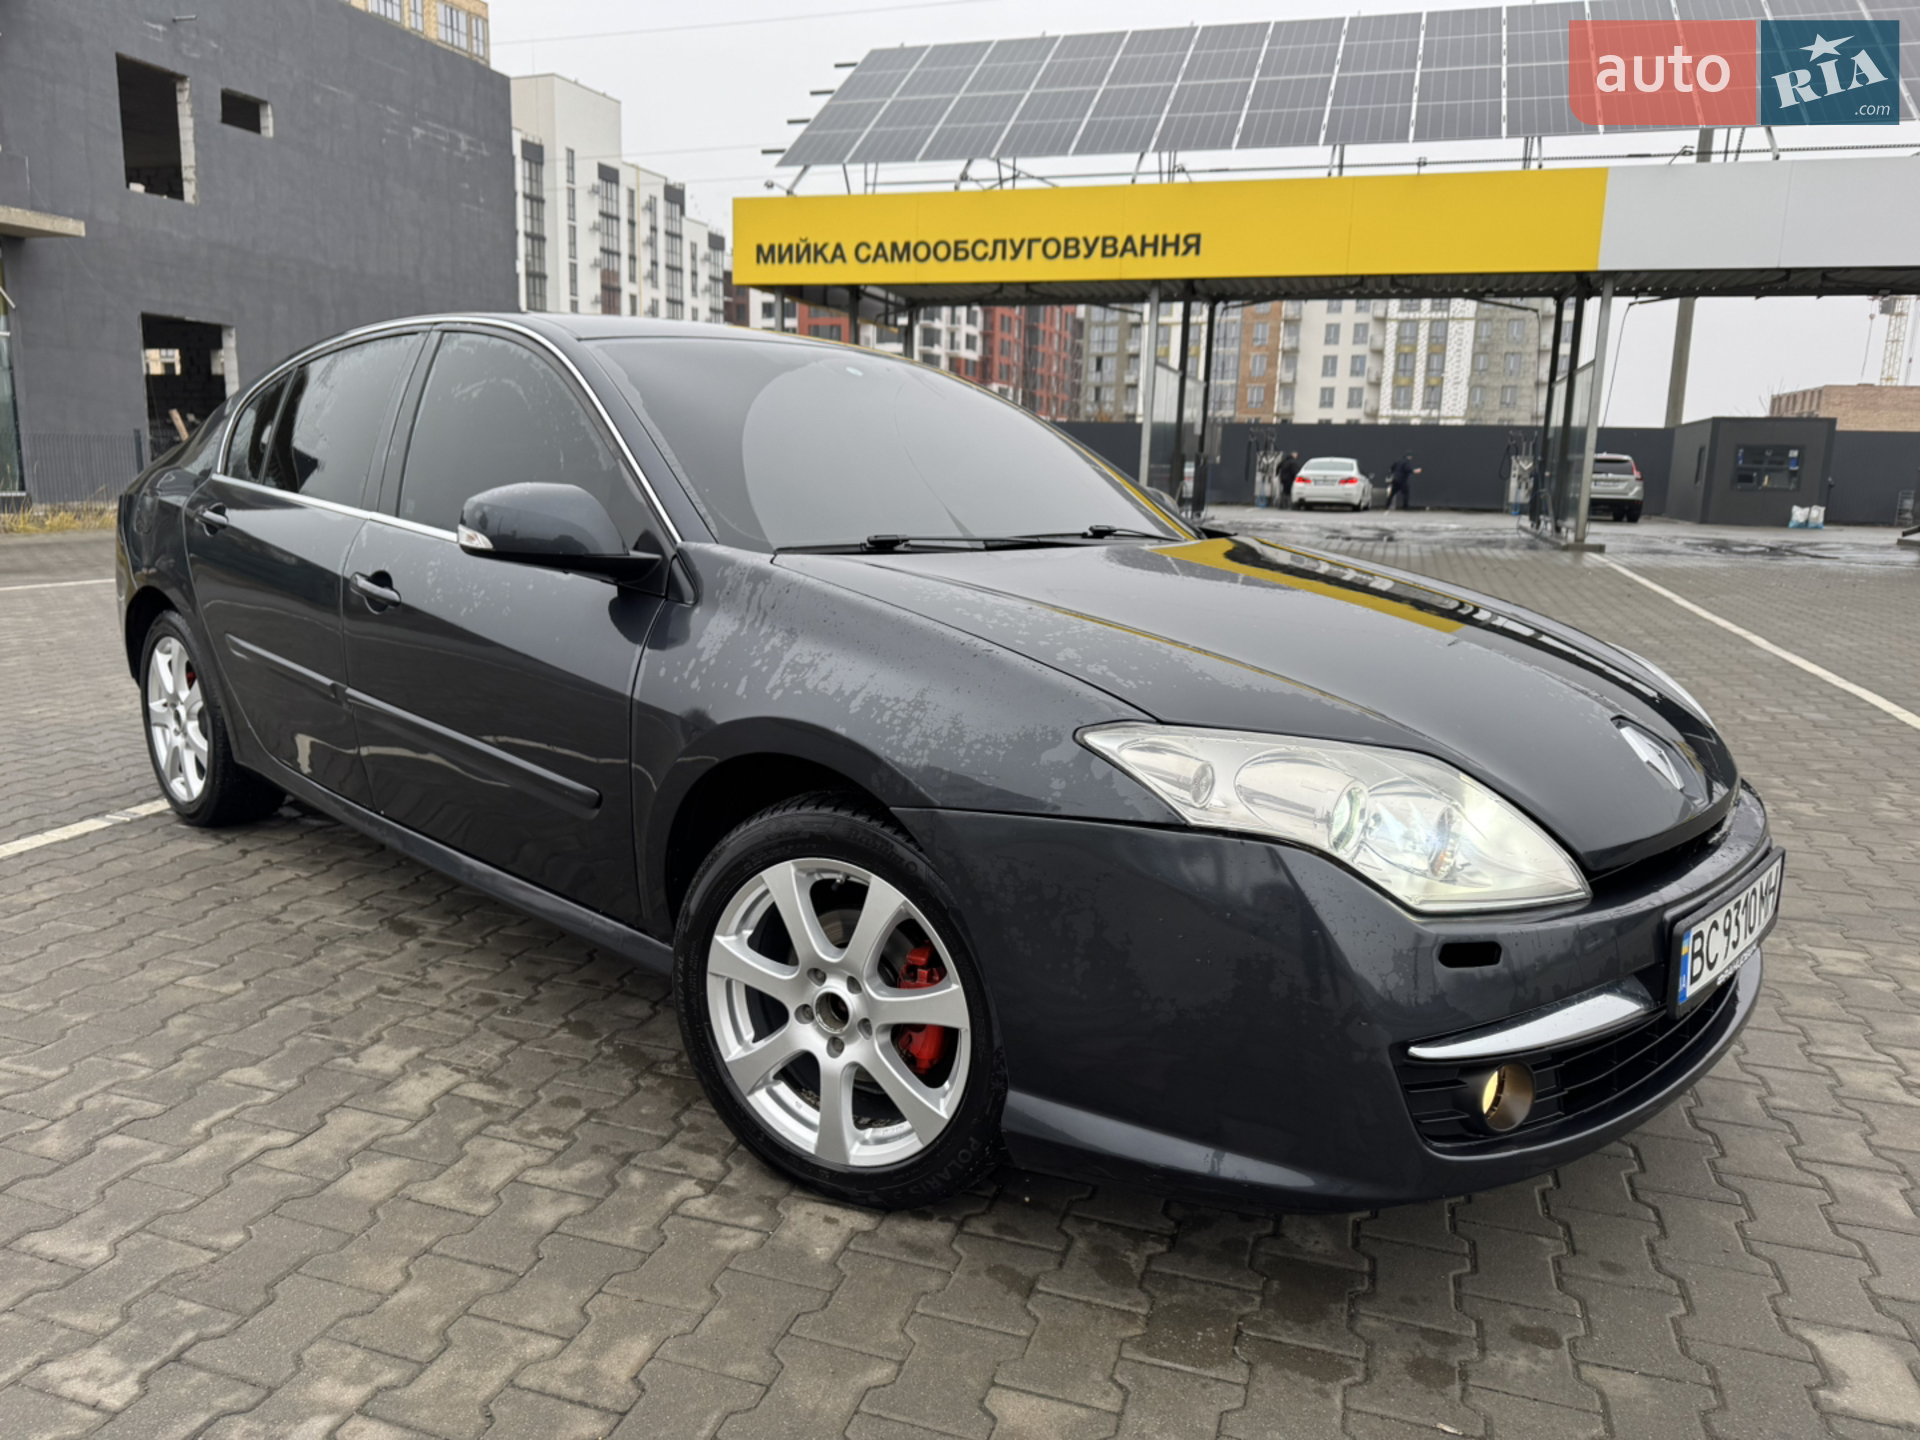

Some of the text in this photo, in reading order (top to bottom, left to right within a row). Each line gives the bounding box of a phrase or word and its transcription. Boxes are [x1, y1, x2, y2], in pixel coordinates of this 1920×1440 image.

[755, 233, 1202, 265] МИЙКА САМООБСЛУГОВУВАННЯ
[908, 1135, 982, 1198] POLARIS
